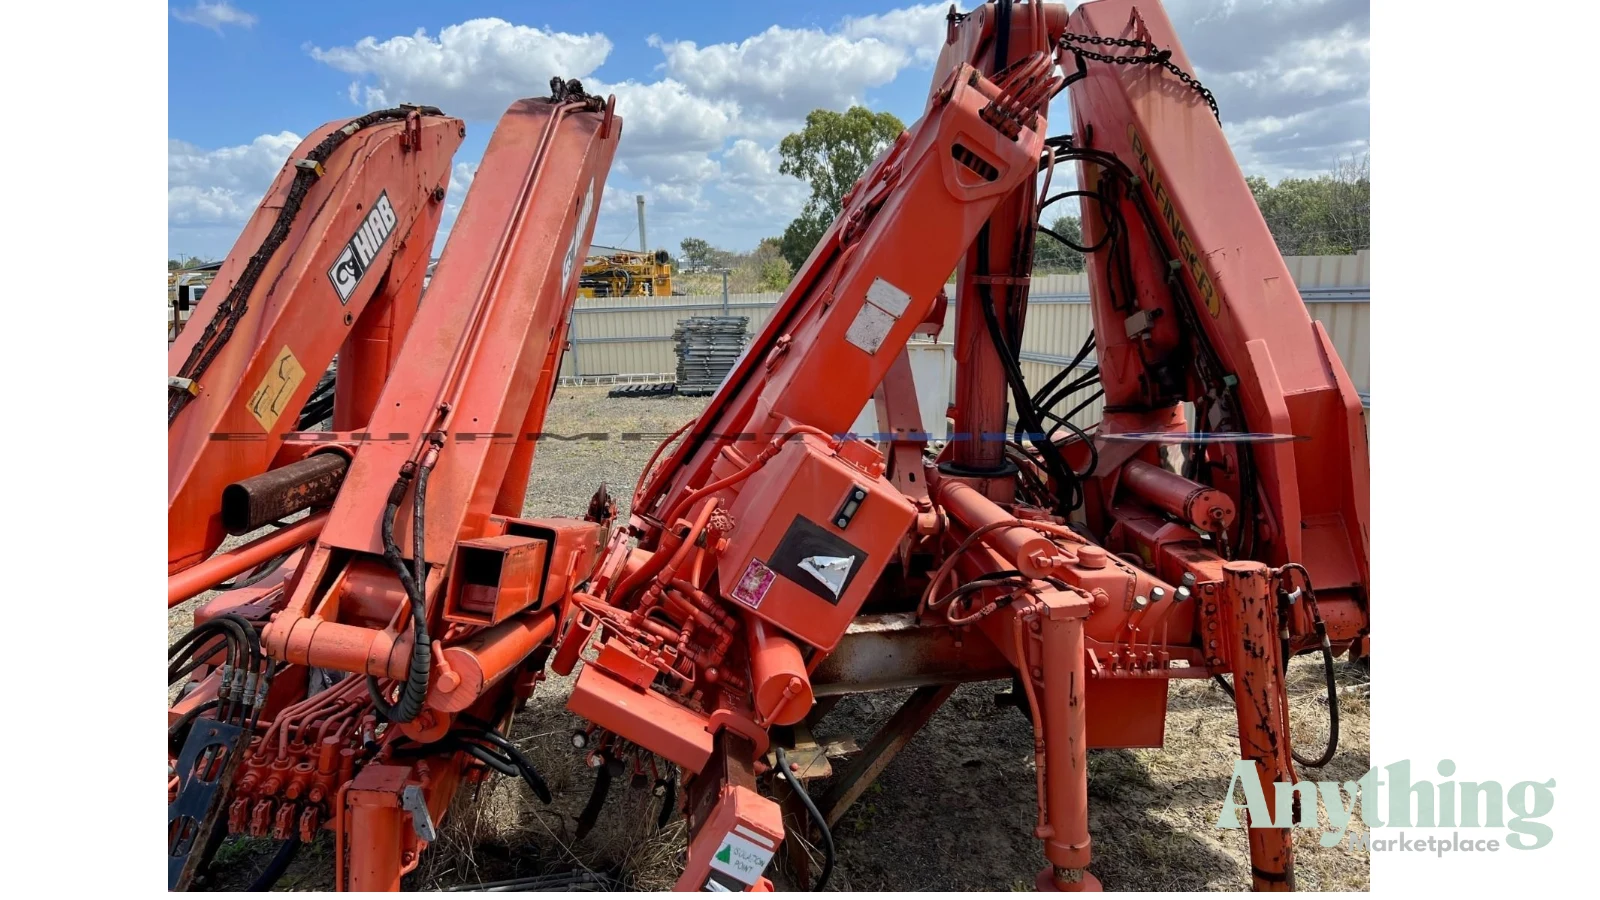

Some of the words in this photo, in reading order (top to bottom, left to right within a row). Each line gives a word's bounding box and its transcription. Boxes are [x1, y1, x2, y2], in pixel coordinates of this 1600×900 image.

[353, 195, 396, 267] HIAB
[1133, 133, 1213, 303] PALFINGER
[735, 860, 753, 873] POINT
